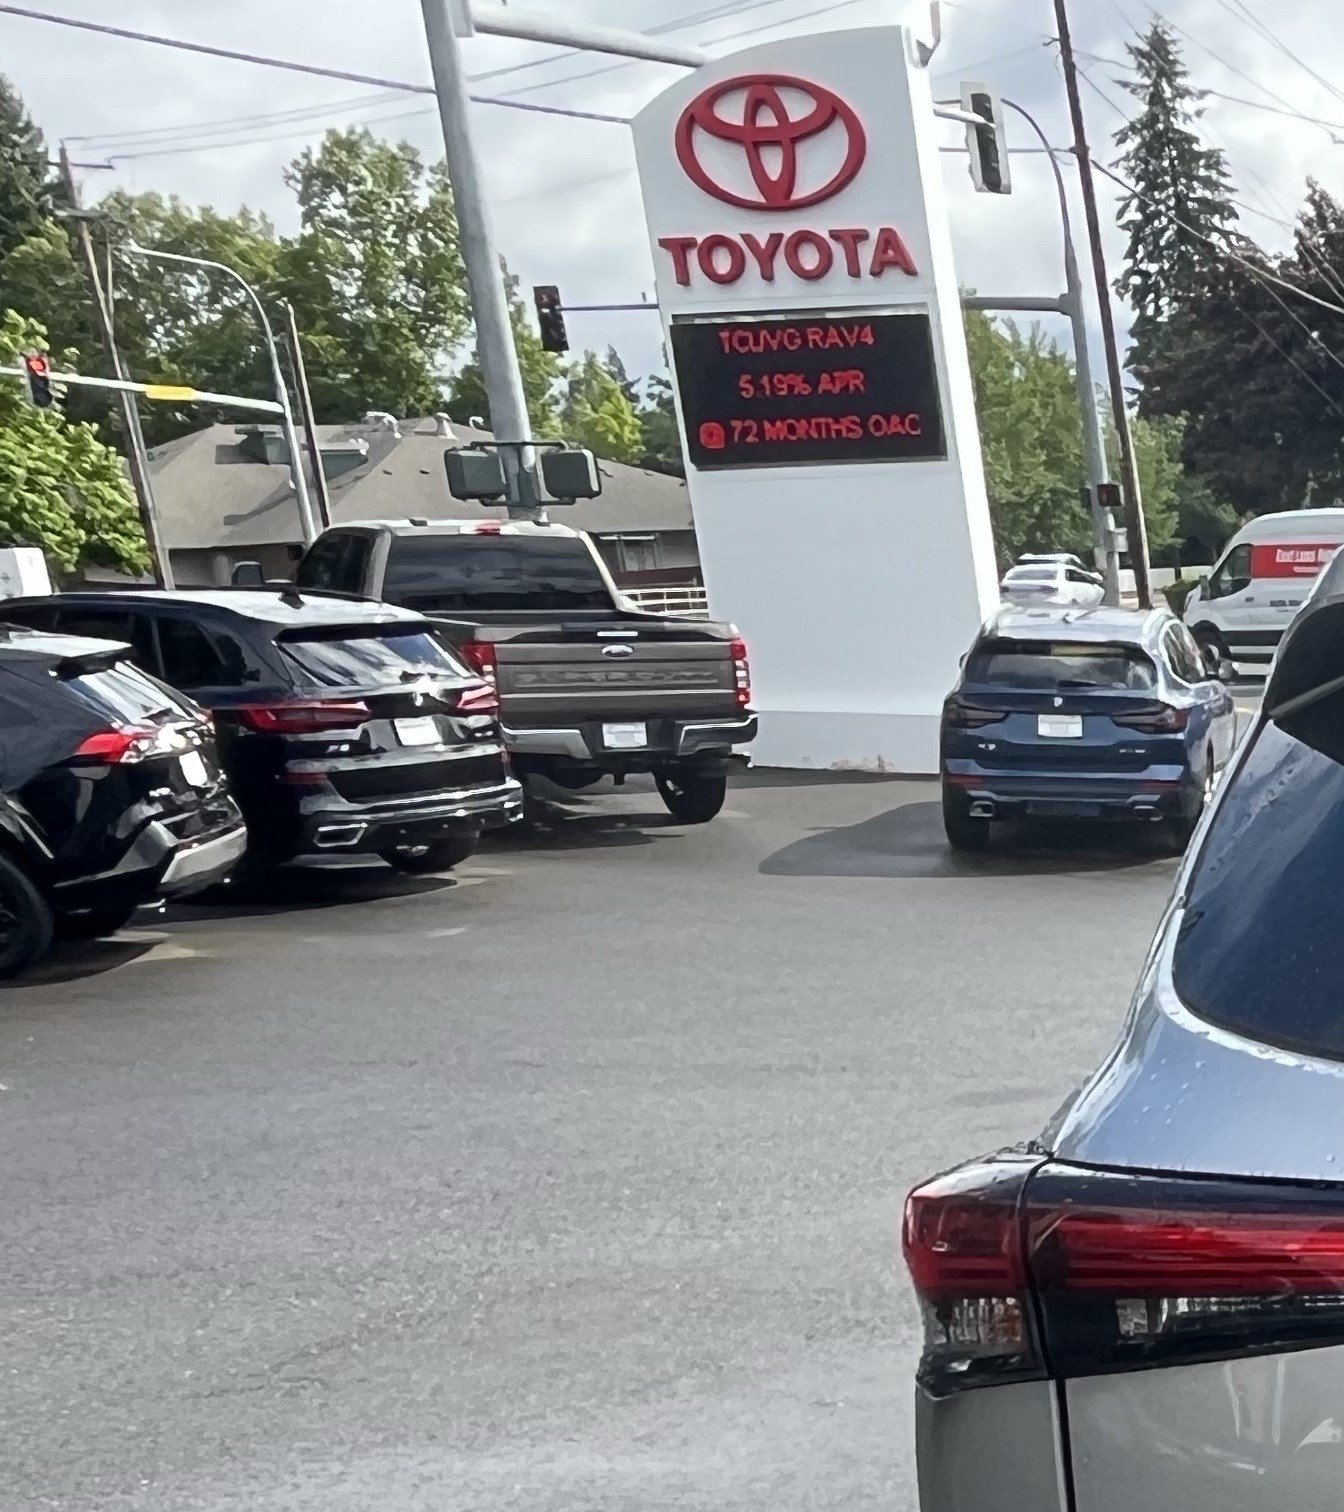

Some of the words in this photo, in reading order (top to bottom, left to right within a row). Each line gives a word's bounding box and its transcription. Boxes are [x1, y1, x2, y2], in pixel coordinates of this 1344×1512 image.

[658, 227, 918, 287] TOYOTA
[806, 324, 875, 350] RAV4
[817, 369, 866, 395] APR
[730, 419, 759, 444] 72
[762, 414, 864, 443] MONTHS
